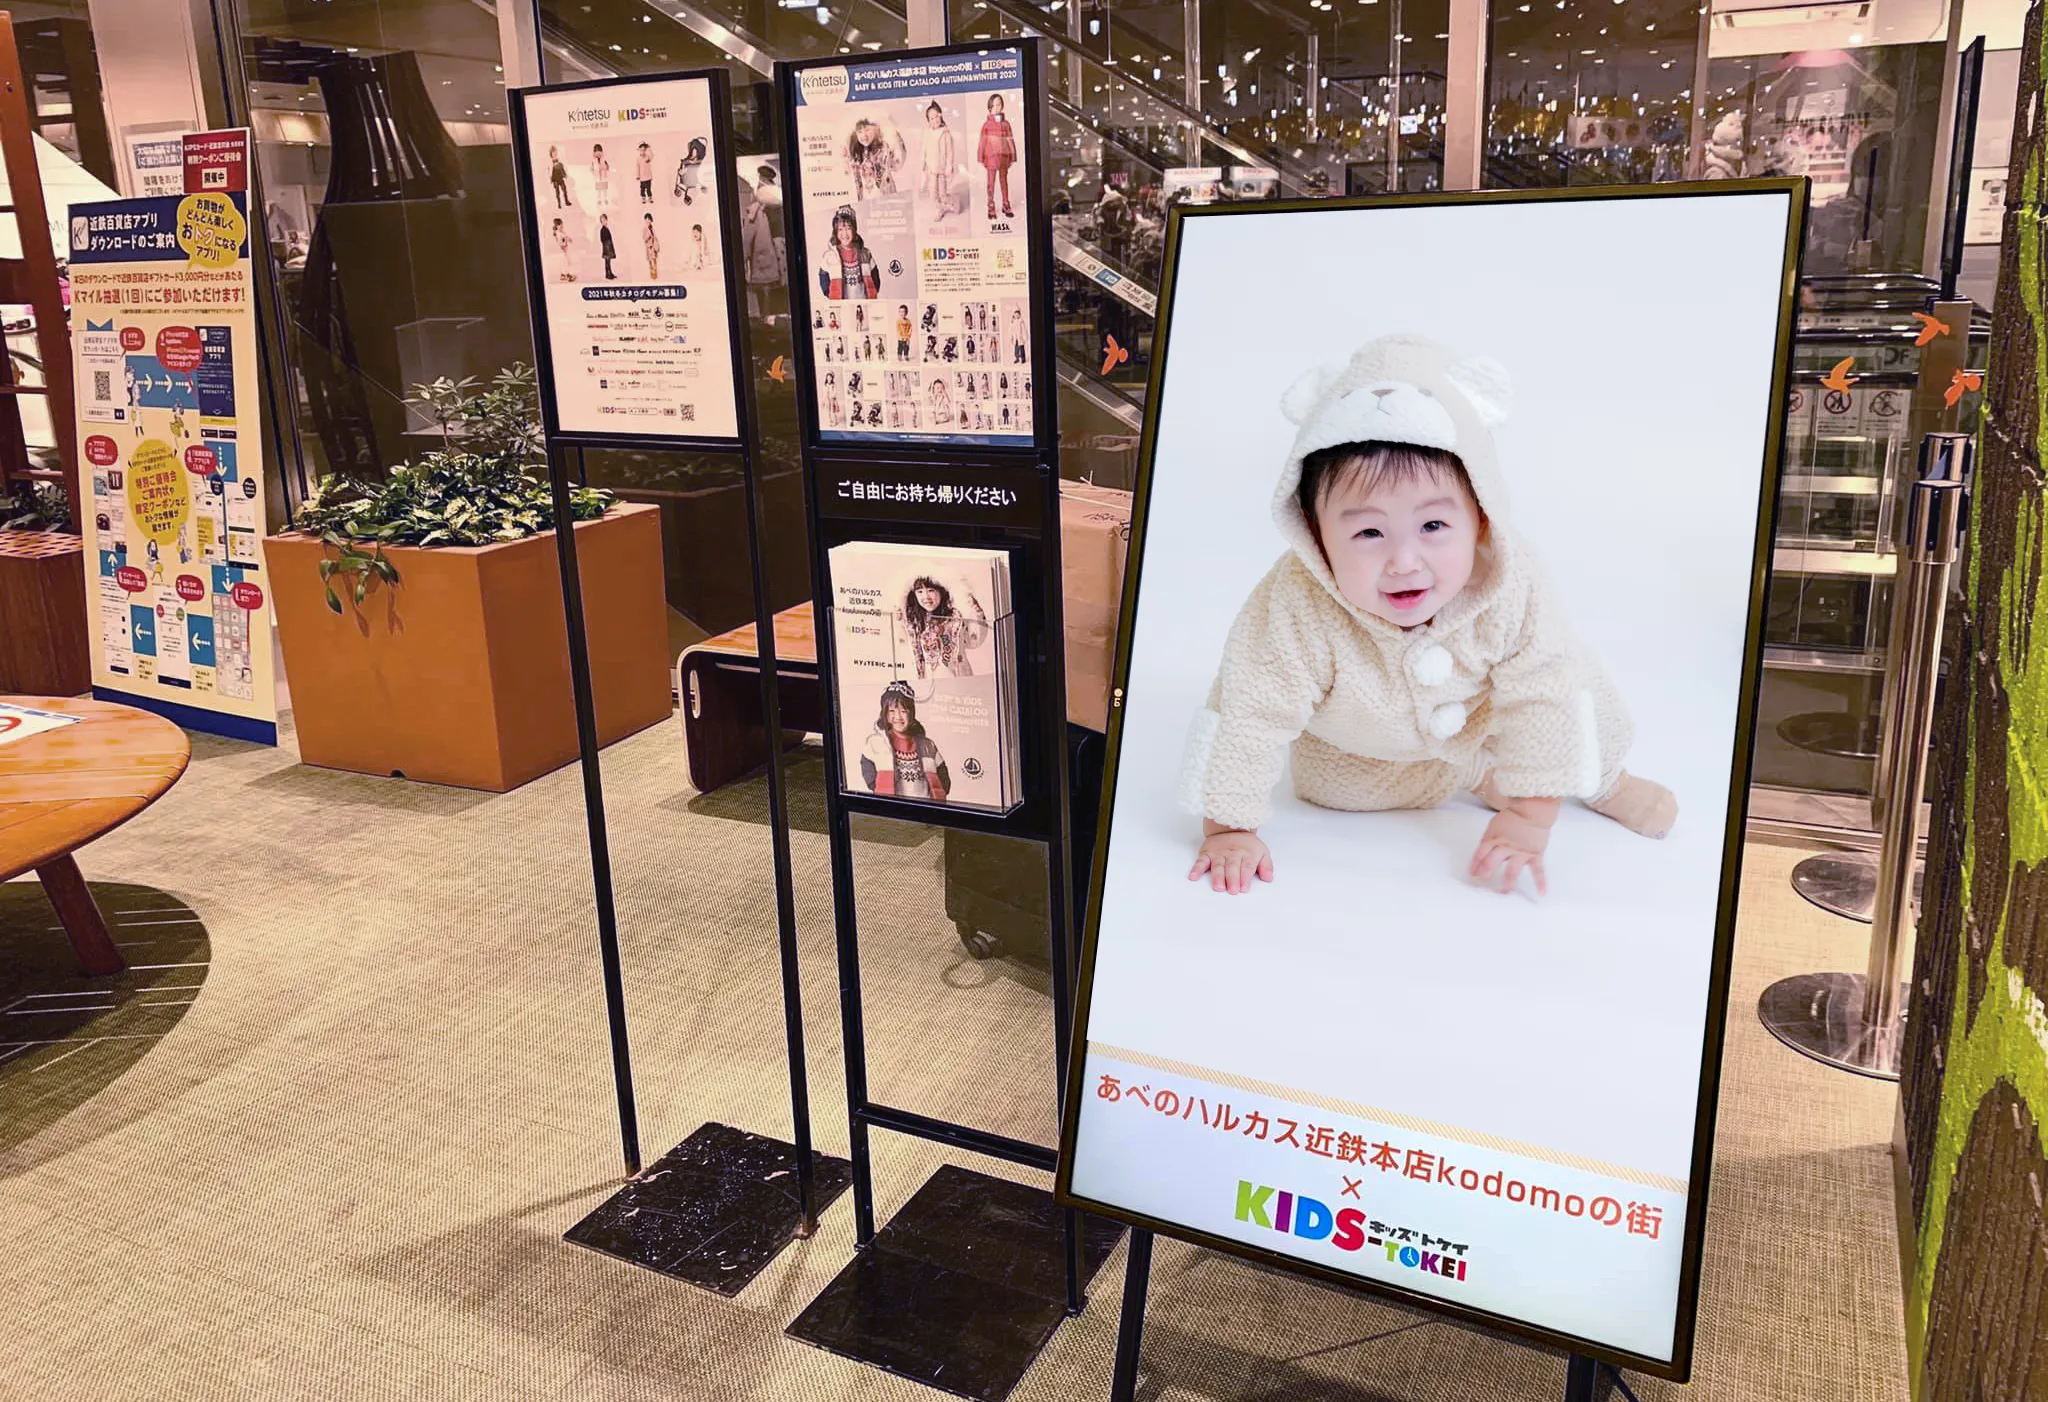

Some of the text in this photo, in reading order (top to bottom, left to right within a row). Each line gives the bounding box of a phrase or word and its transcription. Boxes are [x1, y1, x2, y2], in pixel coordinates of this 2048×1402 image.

[893, 80, 908, 88] ITEM
[909, 76, 940, 86] CATALOG
[999, 70, 1017, 79] 2020
[618, 108, 646, 122] KIDS
[89, 212, 158, 231] 近鉄百貨店アプリ
[186, 209, 234, 230] どんどん楽しく
[90, 232, 176, 251] ダウンロードのご案内
[923, 248, 956, 260] KIDS
[838, 479, 1017, 506] ご自由にお持ち帰りください
[1096, 1073, 1663, 1241] あべのハルカス近鉄本店kodomoの街
